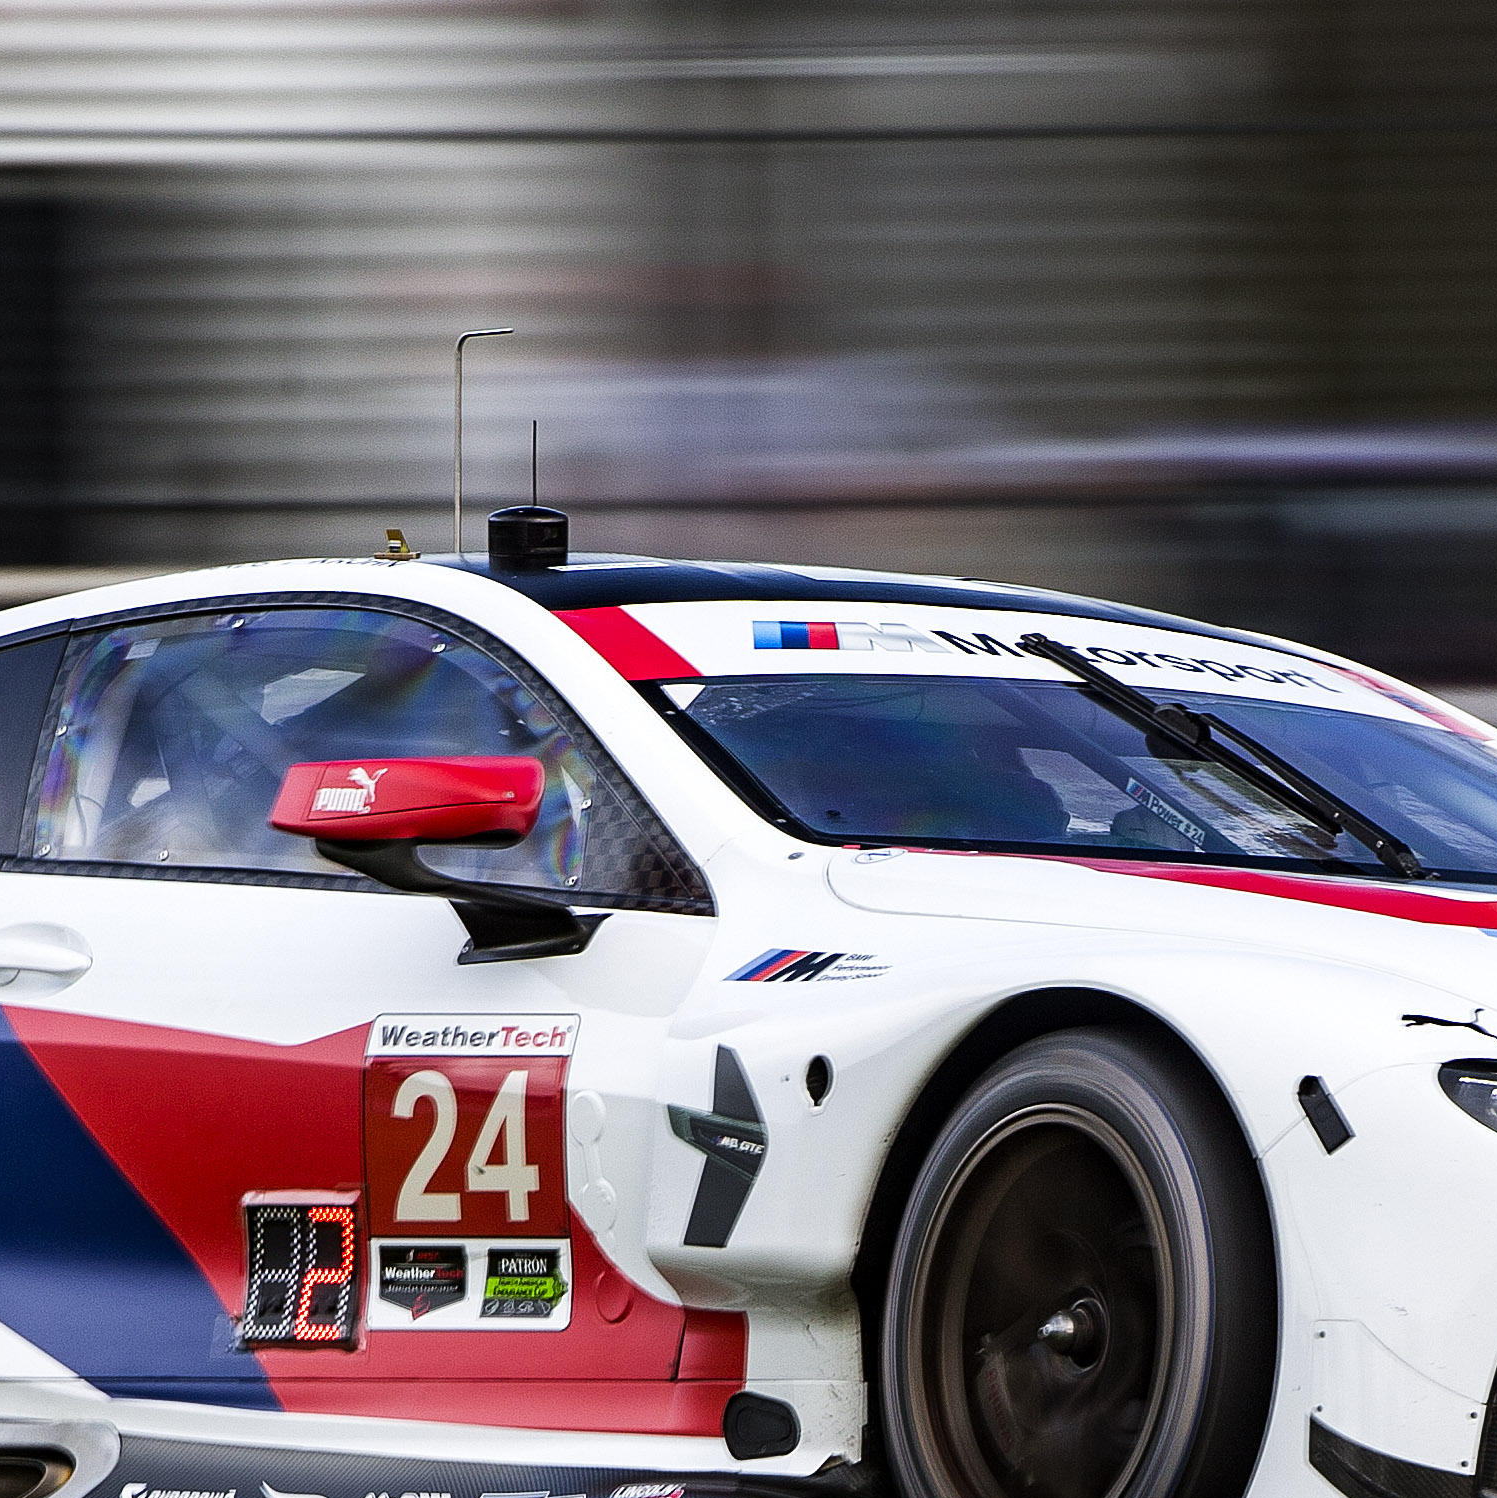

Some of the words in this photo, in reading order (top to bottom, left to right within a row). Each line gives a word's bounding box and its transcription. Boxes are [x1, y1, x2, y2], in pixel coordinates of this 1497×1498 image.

[929, 629, 1343, 693] Morsport
[311, 788, 367, 812] PUMA
[392, 1069, 541, 1223] 24
[500, 1255, 548, 1275] PATRÓN
